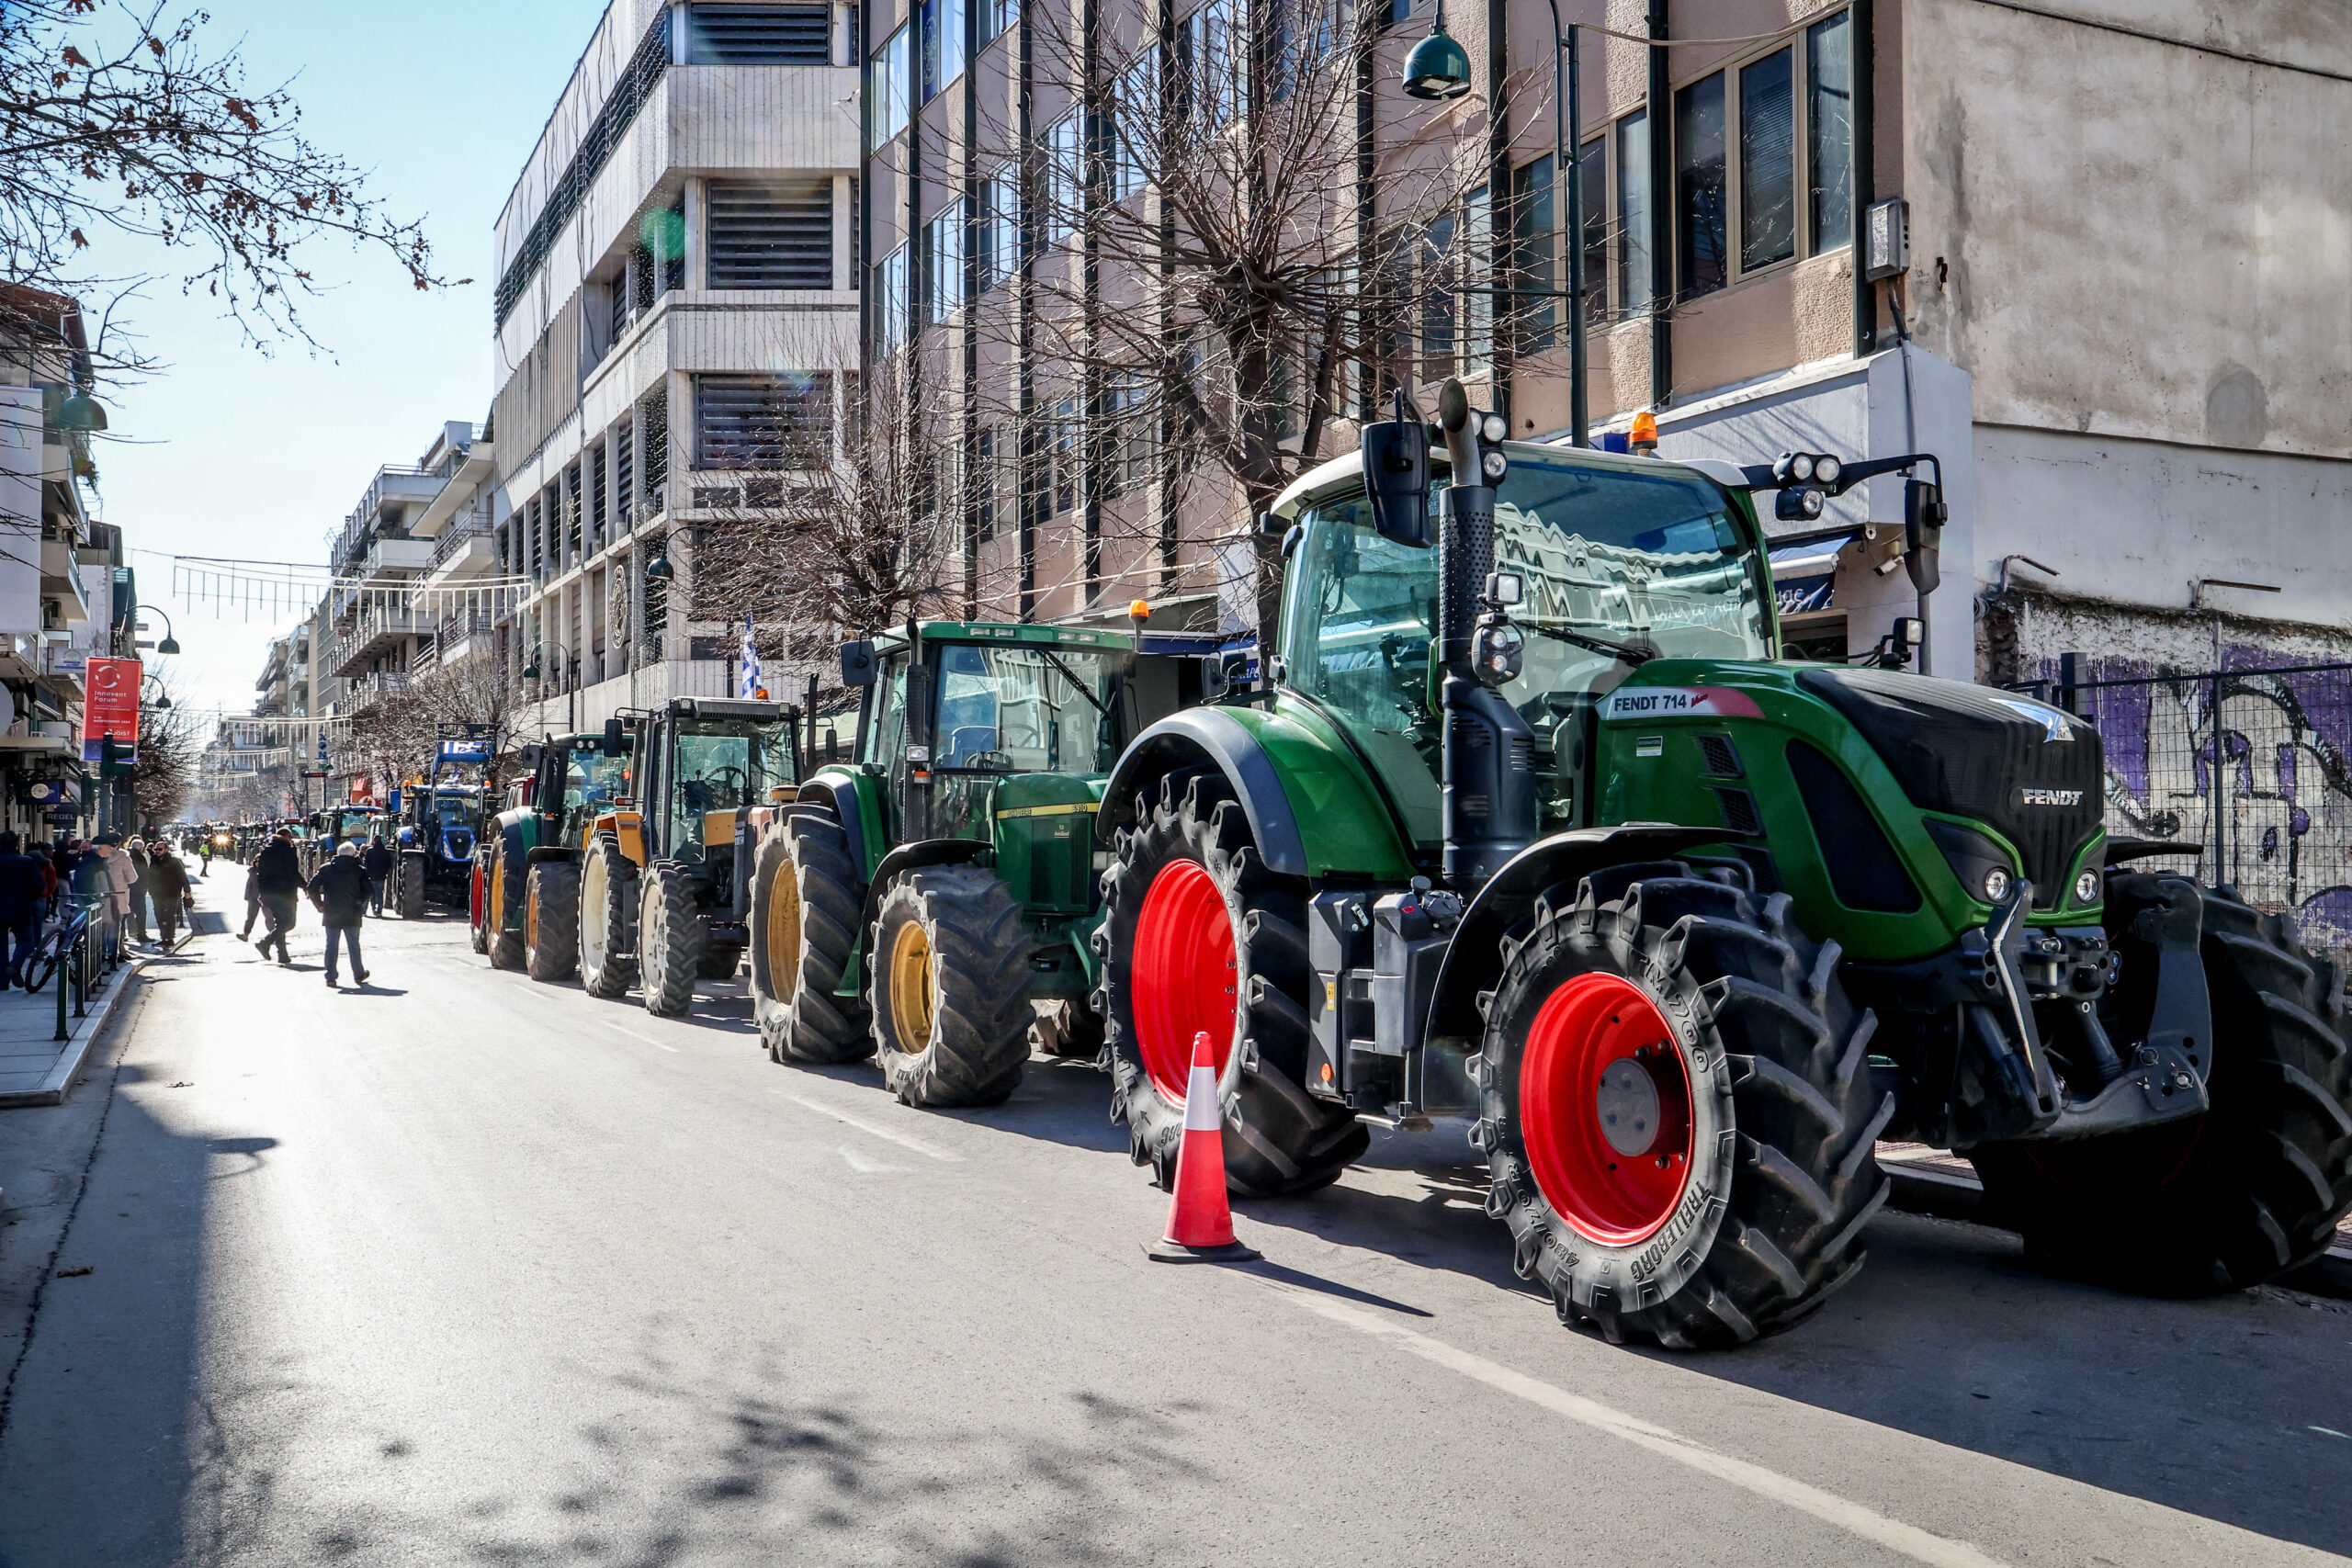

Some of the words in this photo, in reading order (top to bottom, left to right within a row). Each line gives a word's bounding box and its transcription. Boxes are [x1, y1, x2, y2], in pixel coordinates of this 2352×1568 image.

[94, 690, 127, 698] Innovent
[1614, 696, 1658, 712] FENDT
[1663, 694, 1687, 709] 714
[2022, 788, 2084, 806] FENDT
[1630, 1180, 1713, 1282] TRELLEBORG
